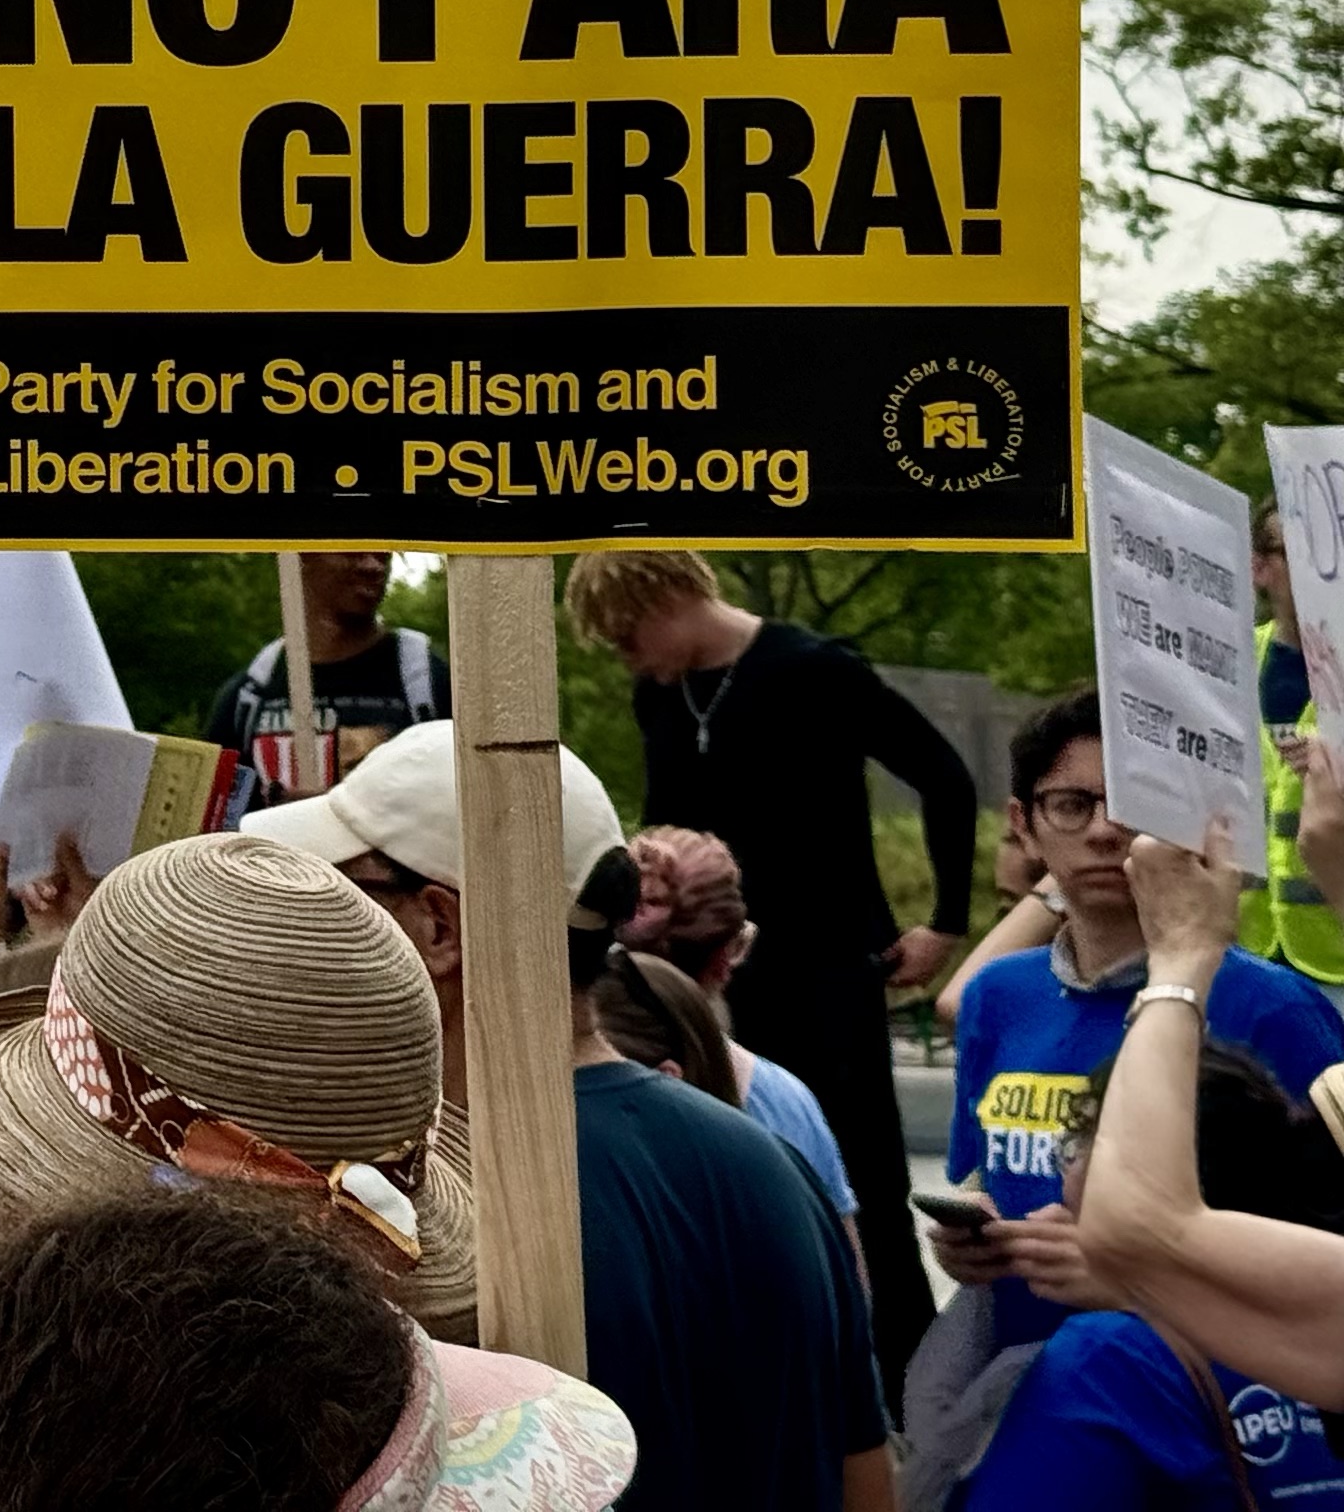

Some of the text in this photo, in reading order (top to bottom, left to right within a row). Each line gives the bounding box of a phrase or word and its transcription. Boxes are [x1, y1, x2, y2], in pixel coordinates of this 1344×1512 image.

[240, 96, 1004, 265] GUERRA!
[152, 356, 245, 416] for
[261, 357, 582, 419] Socialism
[598, 355, 720, 413] and
[882, 360, 940, 452] SOCIALISM
[966, 360, 1024, 462] LIBERATION
[923, 414, 988, 449] PSL
[401, 437, 811, 508] PSLWeb.org
[896, 455, 935, 487] FOR
[940, 462, 1006, 491] PARTY
[1155, 623, 1184, 661] are
[1177, 726, 1209, 762] are
[986, 1127, 1057, 1178] FOR
